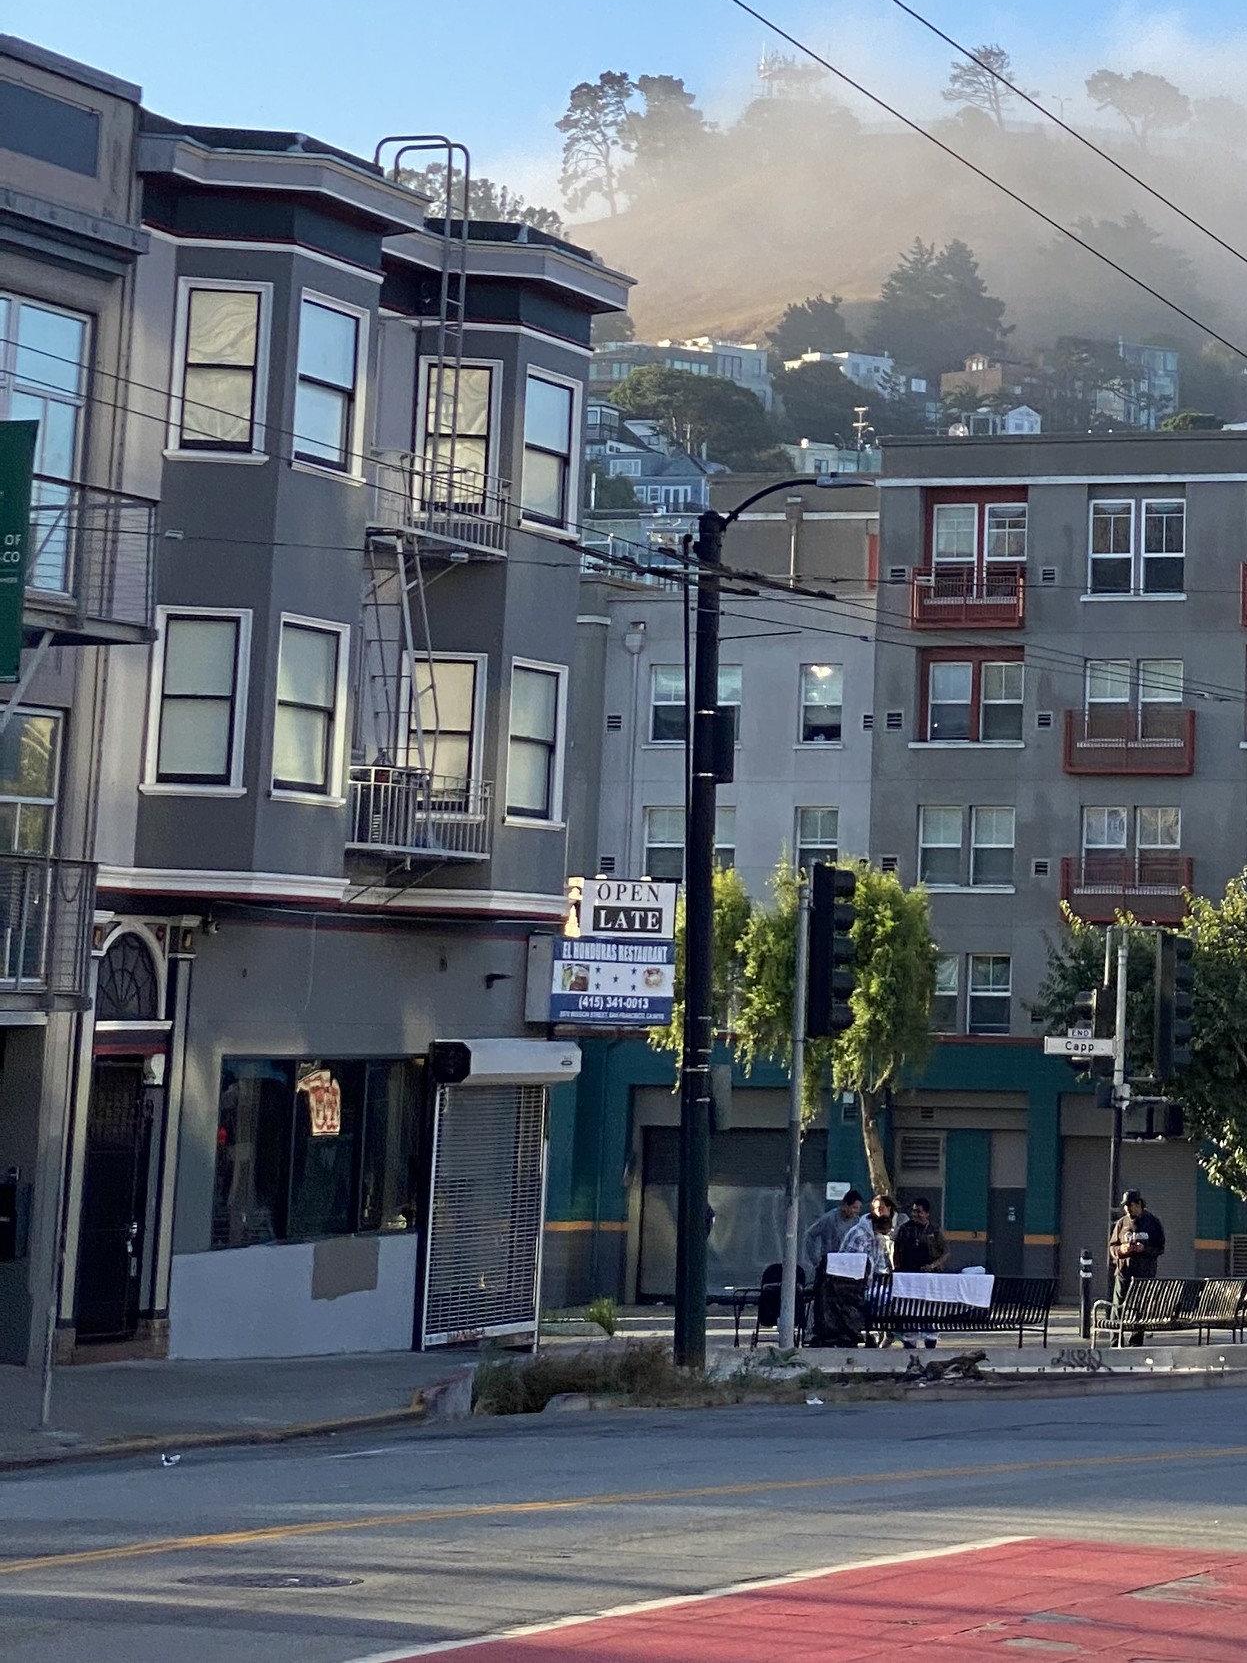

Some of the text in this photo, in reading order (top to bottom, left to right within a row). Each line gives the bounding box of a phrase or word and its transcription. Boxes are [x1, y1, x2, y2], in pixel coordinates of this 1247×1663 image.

[597, 883, 660, 902] OPEN
[599, 909, 660, 930] LATE
[578, 996, 649, 1010] (415) 341-0013
[1065, 1040, 1095, 1053] Capp
